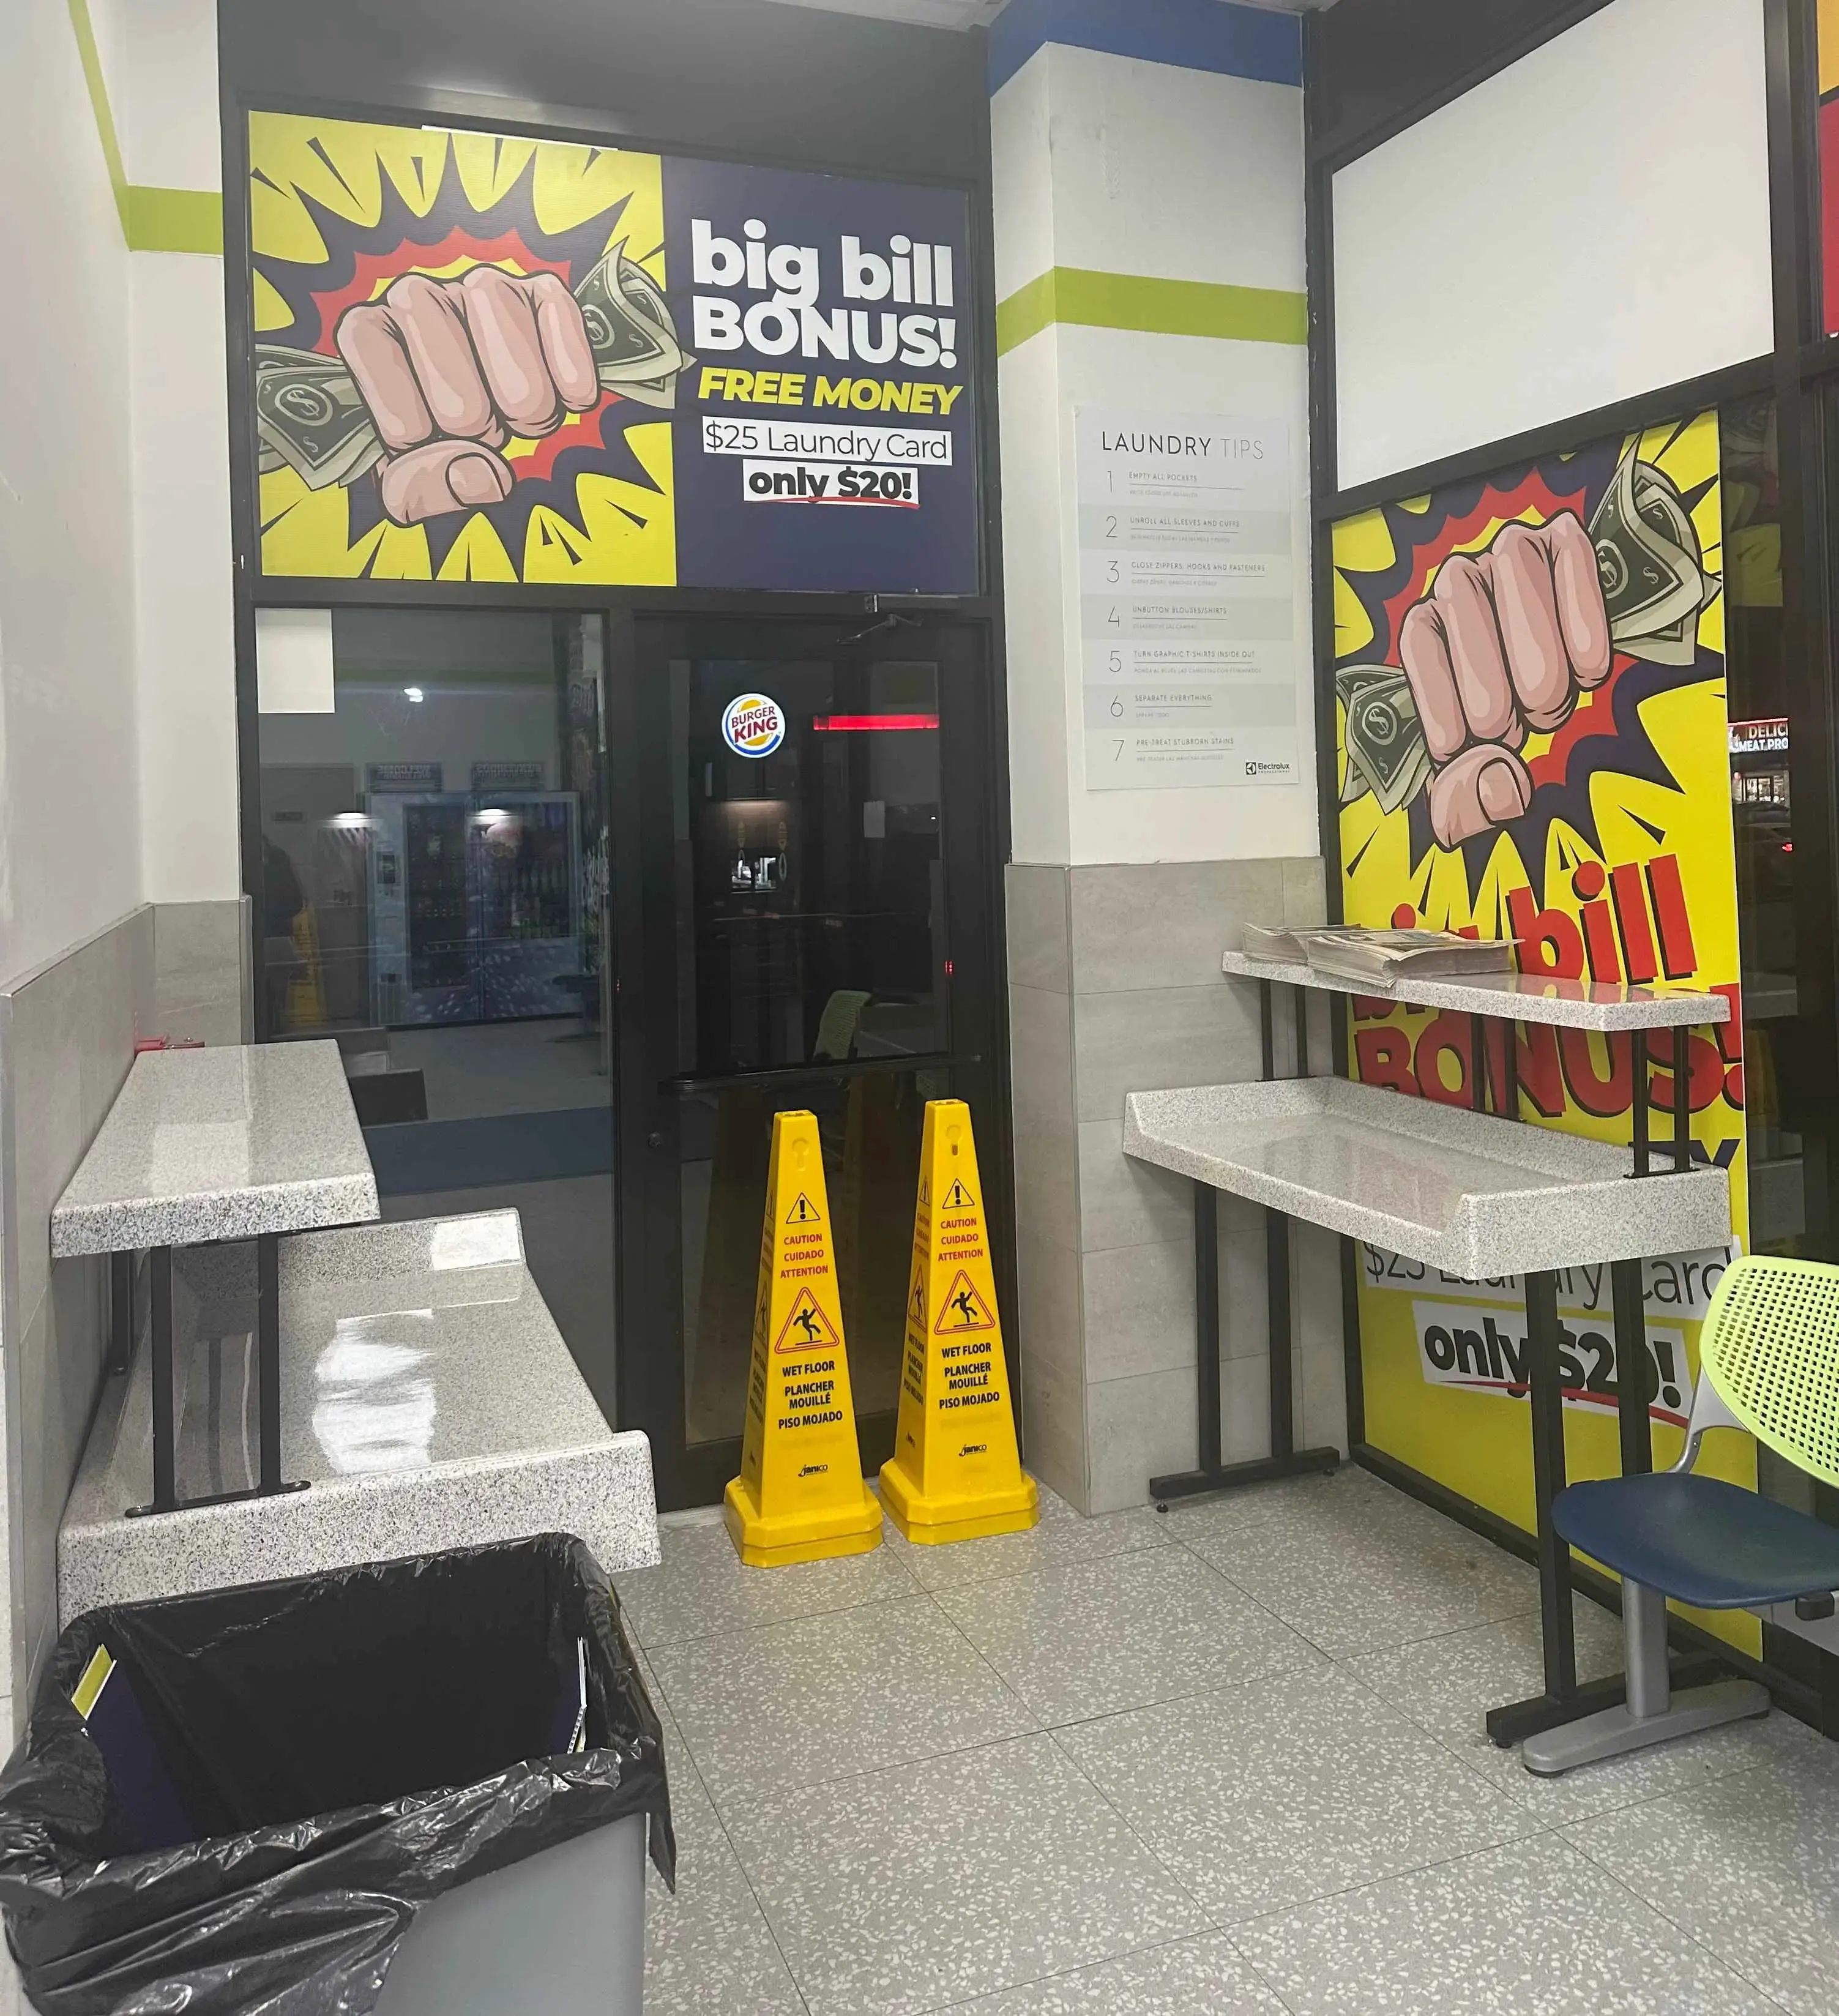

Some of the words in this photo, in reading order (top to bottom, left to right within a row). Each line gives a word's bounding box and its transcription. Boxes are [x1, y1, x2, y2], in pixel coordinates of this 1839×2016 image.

[692, 218, 819, 309] big
[841, 234, 953, 307] bill
[692, 295, 957, 368] BONUS!
[698, 367, 806, 406] FREE
[813, 375, 963, 415] MONEY
[706, 420, 758, 452] $25
[768, 427, 881, 461] Laundry
[886, 433, 947, 460] Card
[1102, 431, 1211, 456] LAUNDRY
[1220, 438, 1264, 460] TIPS
[748, 466, 829, 502] only
[838, 466, 912, 499] $20!
[1106, 470, 1113, 493] 1
[1129, 471, 1150, 480] EMPTY
[1152, 472, 1165, 481] ALL
[1166, 474, 1198, 482] POCKETS
[1106, 515, 1119, 538] 2
[1130, 517, 1157, 525] UNROLL
[1106, 561, 1120, 583] 3
[1186, 562, 1211, 571] HOOKS
[1229, 564, 1266, 572] FASTENERS
[1108, 605, 1121, 627] 4
[1109, 650, 1122, 673] 5
[731, 706, 775, 728] BURGER
[1110, 695, 1124, 717] 6
[734, 716, 778, 744] KING
[1111, 739, 1125, 761] 7
[1739, 739, 1766, 752] MEAT
[1506, 854, 1699, 985] bill
[941, 1217, 977, 1229] CAUTION
[784, 1234, 822, 1245] CAUTION
[941, 1233, 979, 1245] CUIDADO
[784, 1249, 824, 1261] CUIDADO
[938, 1249, 983, 1261] ATTENTION
[780, 1265, 828, 1278] ATTENTION
[1643, 1247, 1731, 1305] ard
[942, 1346, 961, 1358] WET
[963, 1342, 991, 1355] FLOOR
[782, 1365, 802, 1377] WET
[805, 1361, 835, 1374] FLOOR
[944, 1362, 991, 1377] PLANCHER
[1424, 1317, 1530, 1398] only
[1557, 1319, 1682, 1408] $2!
[785, 1380, 834, 1397] PLANCHER
[949, 1373, 988, 1390] MOUILLÉ
[789, 1392, 830, 1409] MOUILLÉ
[939, 1396, 960, 1409] PISO
[962, 1391, 999, 1406] MOJADO
[778, 1416, 800, 1429] PISO
[802, 1410, 843, 1426] MOJADO
